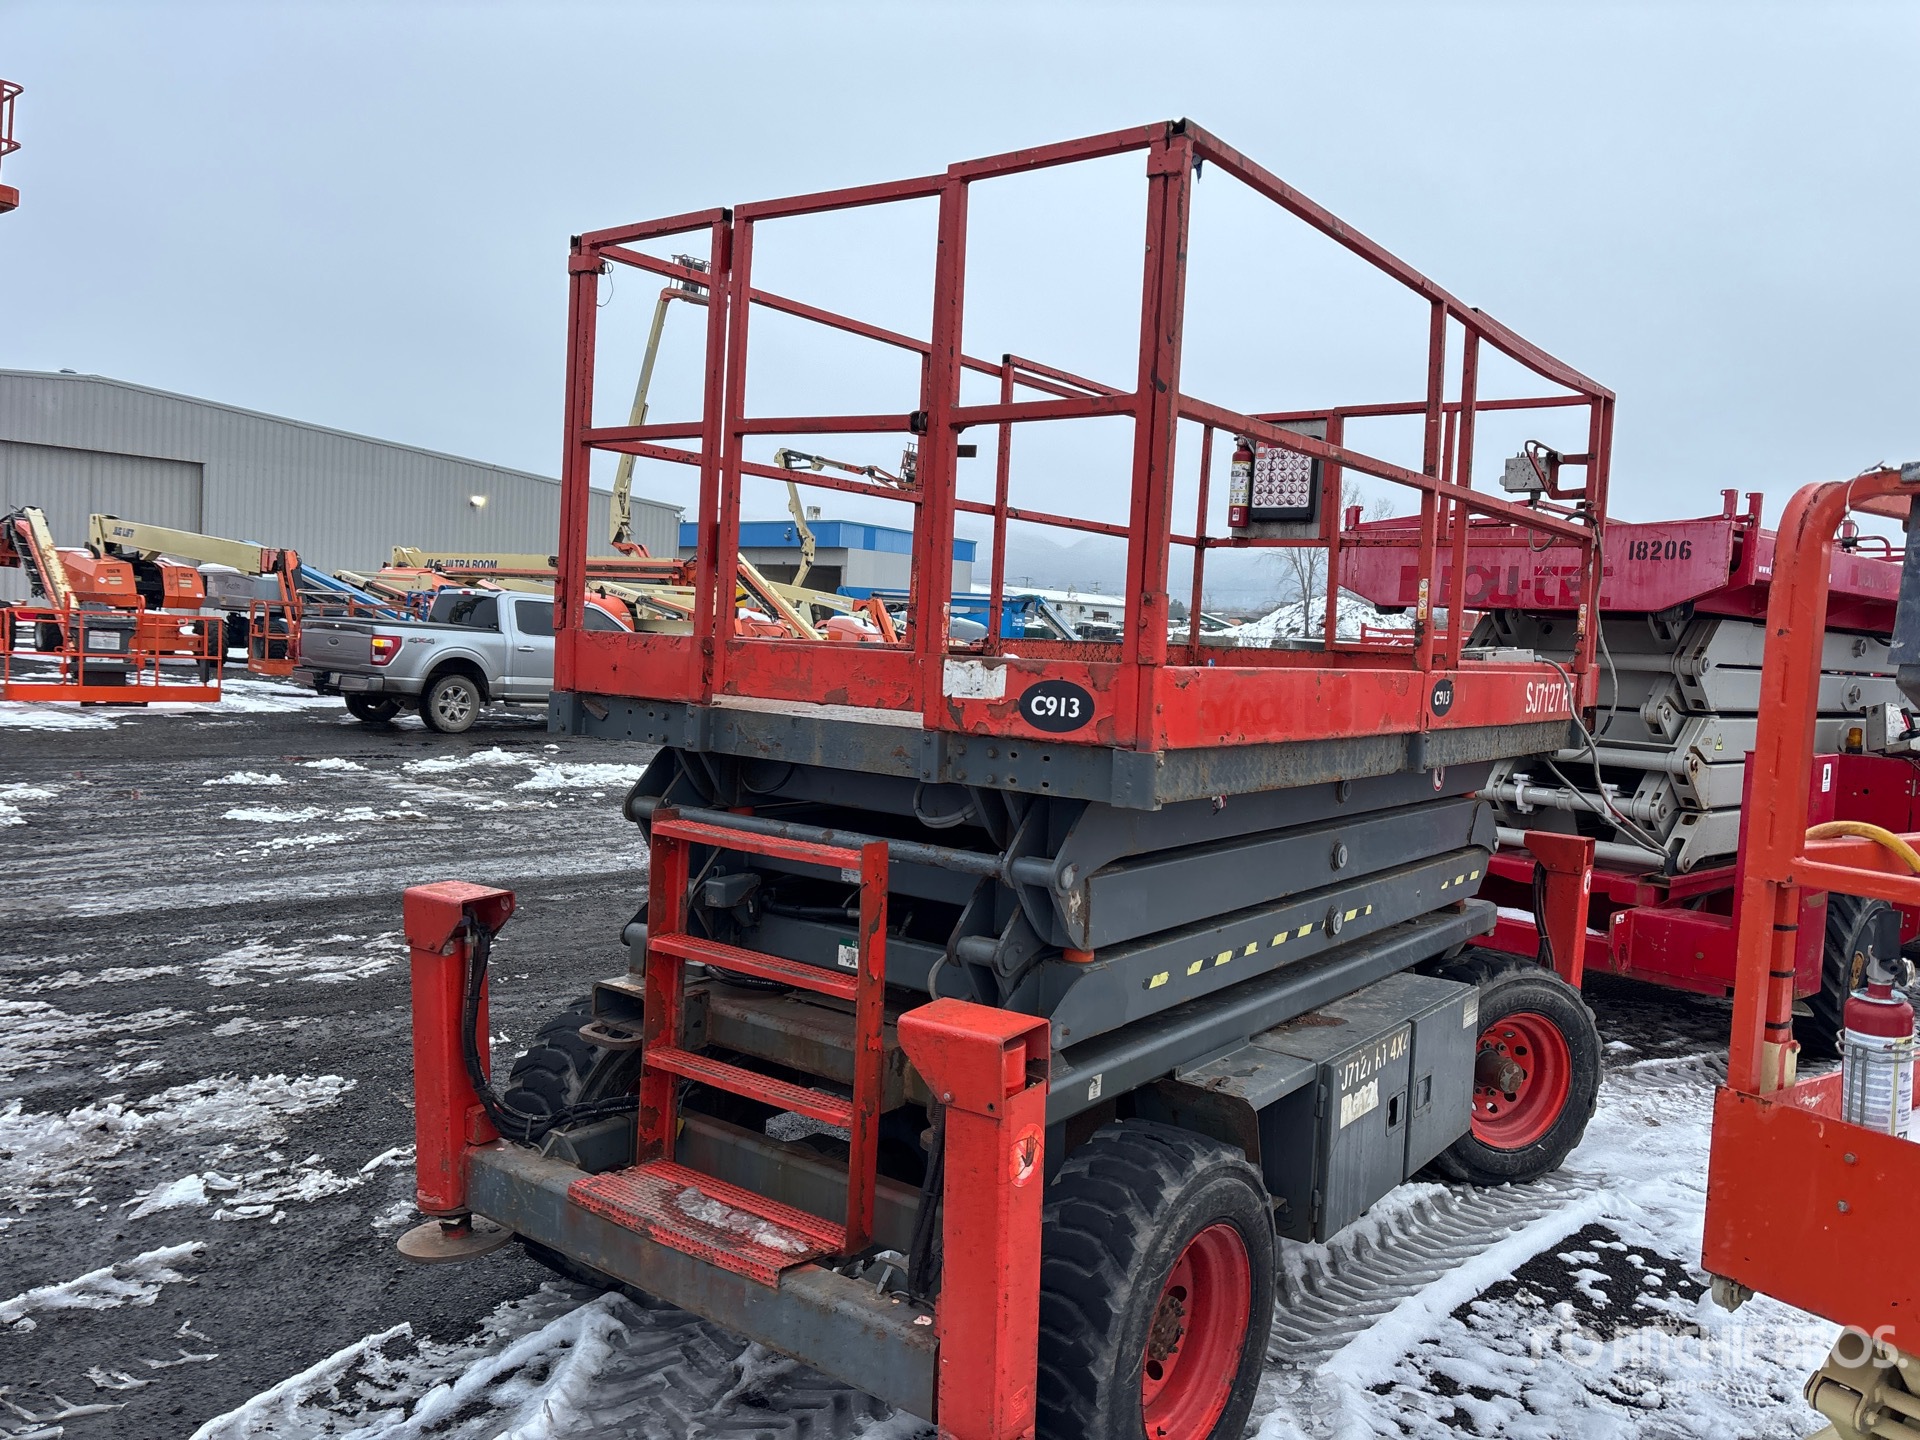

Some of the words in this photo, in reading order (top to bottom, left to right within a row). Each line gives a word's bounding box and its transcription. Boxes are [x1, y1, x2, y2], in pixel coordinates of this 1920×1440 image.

[123, 528, 134, 538] LIFT
[1629, 540, 1692, 560] 18206
[471, 560, 497, 569] BOOM
[1434, 690, 1450, 706] C913
[1525, 681, 1561, 714] SJ7127
[1031, 695, 1080, 719] C913
